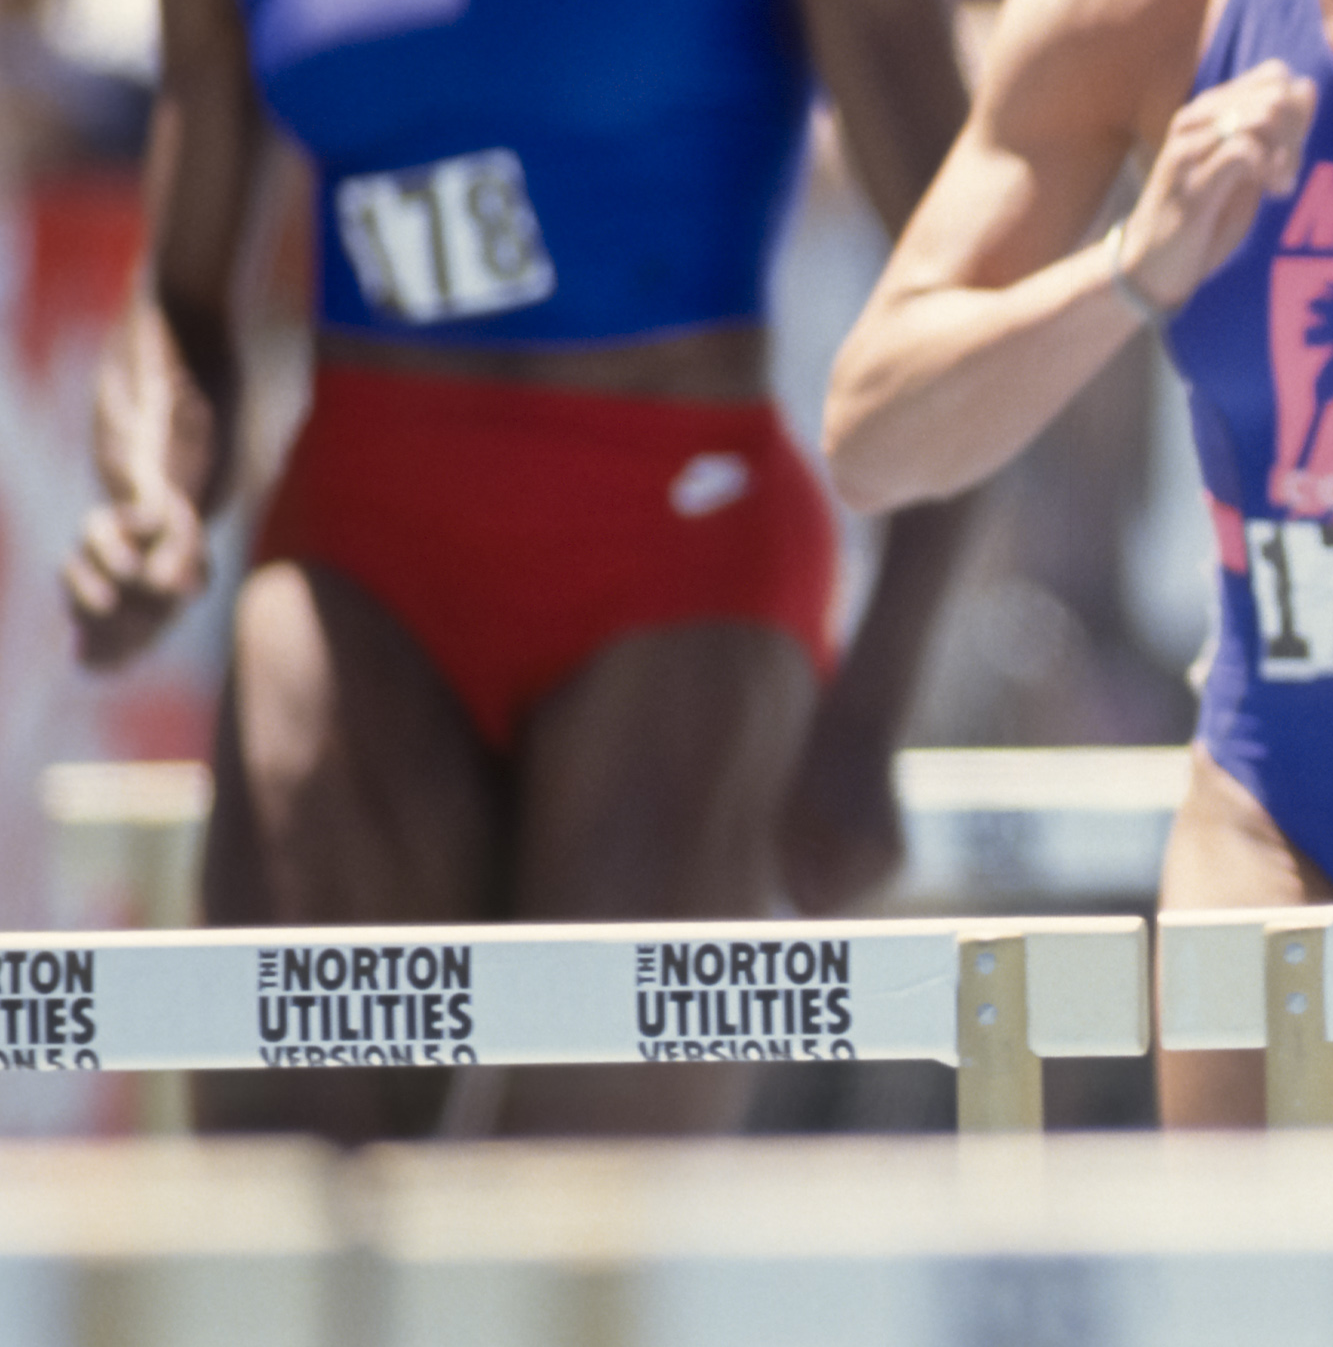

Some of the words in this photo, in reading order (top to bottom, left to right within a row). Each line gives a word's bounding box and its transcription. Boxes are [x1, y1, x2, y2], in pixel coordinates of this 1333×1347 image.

[357, 174, 534, 312] 178
[283, 946, 472, 992] NORTON
[661, 940, 849, 987] NORTON
[258, 993, 474, 1042] UTILITIES
[637, 987, 852, 1038] UTILITIES
